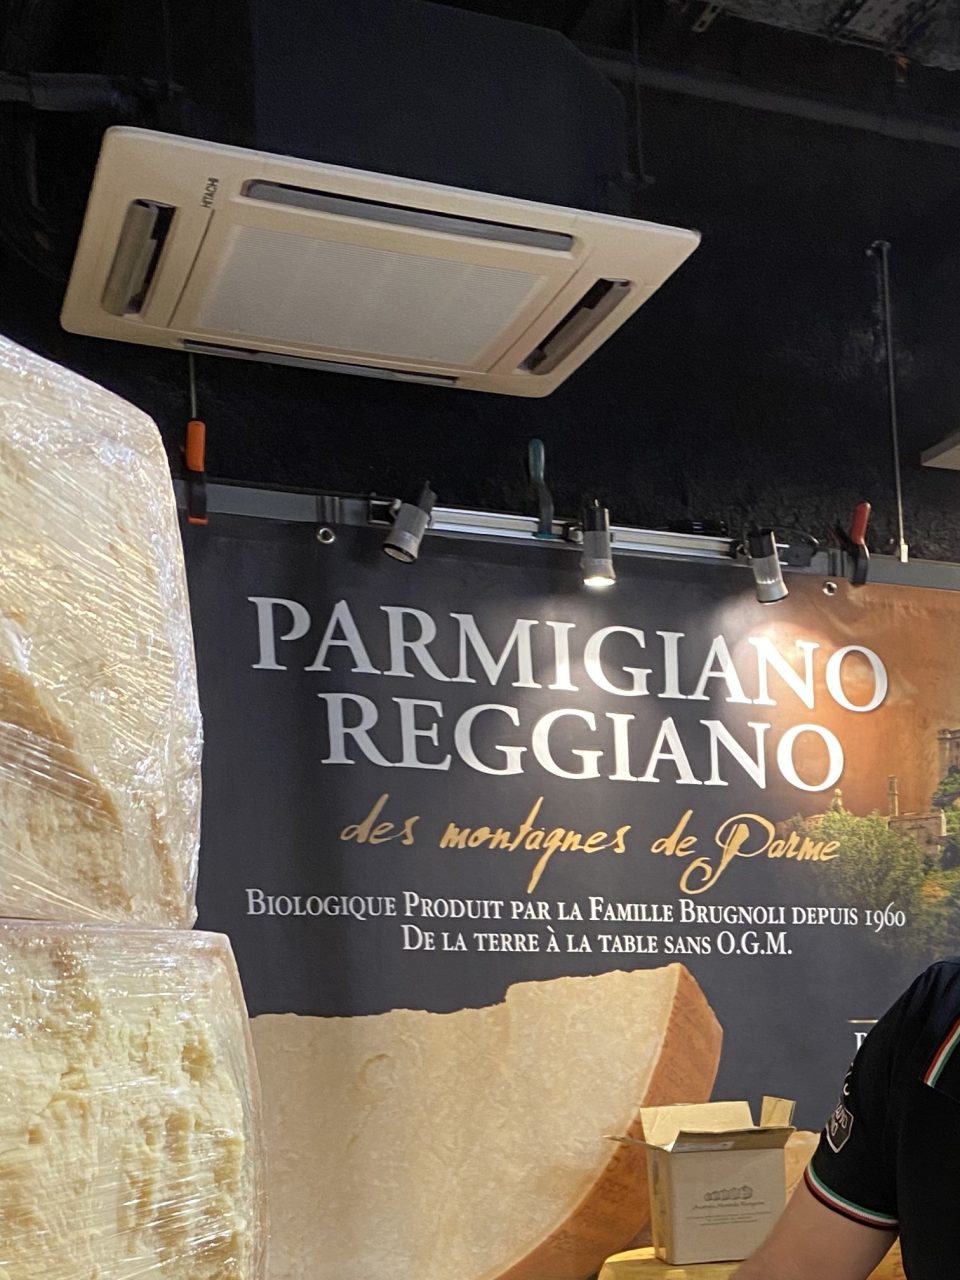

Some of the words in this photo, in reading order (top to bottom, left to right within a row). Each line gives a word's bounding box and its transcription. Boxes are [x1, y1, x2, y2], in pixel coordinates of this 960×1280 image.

[200, 177, 219, 208] HITACHI
[248, 595, 889, 713] PARMIGIANO
[317, 692, 845, 792] REGGIANO
[340, 793, 420, 846] des
[441, 796, 629, 895] montagnes
[651, 809, 698, 858] de
[680, 812, 840, 895] Parme
[246, 888, 397, 920] BIOLOGIQUE
[403, 891, 503, 919] PRODUIT
[510, 901, 552, 921] PAR
[557, 901, 584, 921] LA
[588, 896, 674, 923] FAMILLE
[679, 898, 785, 925] BRUGNOLI
[791, 906, 858, 926] DEPUIS
[865, 902, 906, 932] 1960
[401, 924, 436, 951] DE
[442, 931, 468, 951] LA
[473, 932, 540, 952] TERRE
[567, 933, 592, 953] LA
[598, 933, 658, 954] TABLE
[664, 935, 712, 955] SANS
[716, 930, 793, 955] O.G.M.
